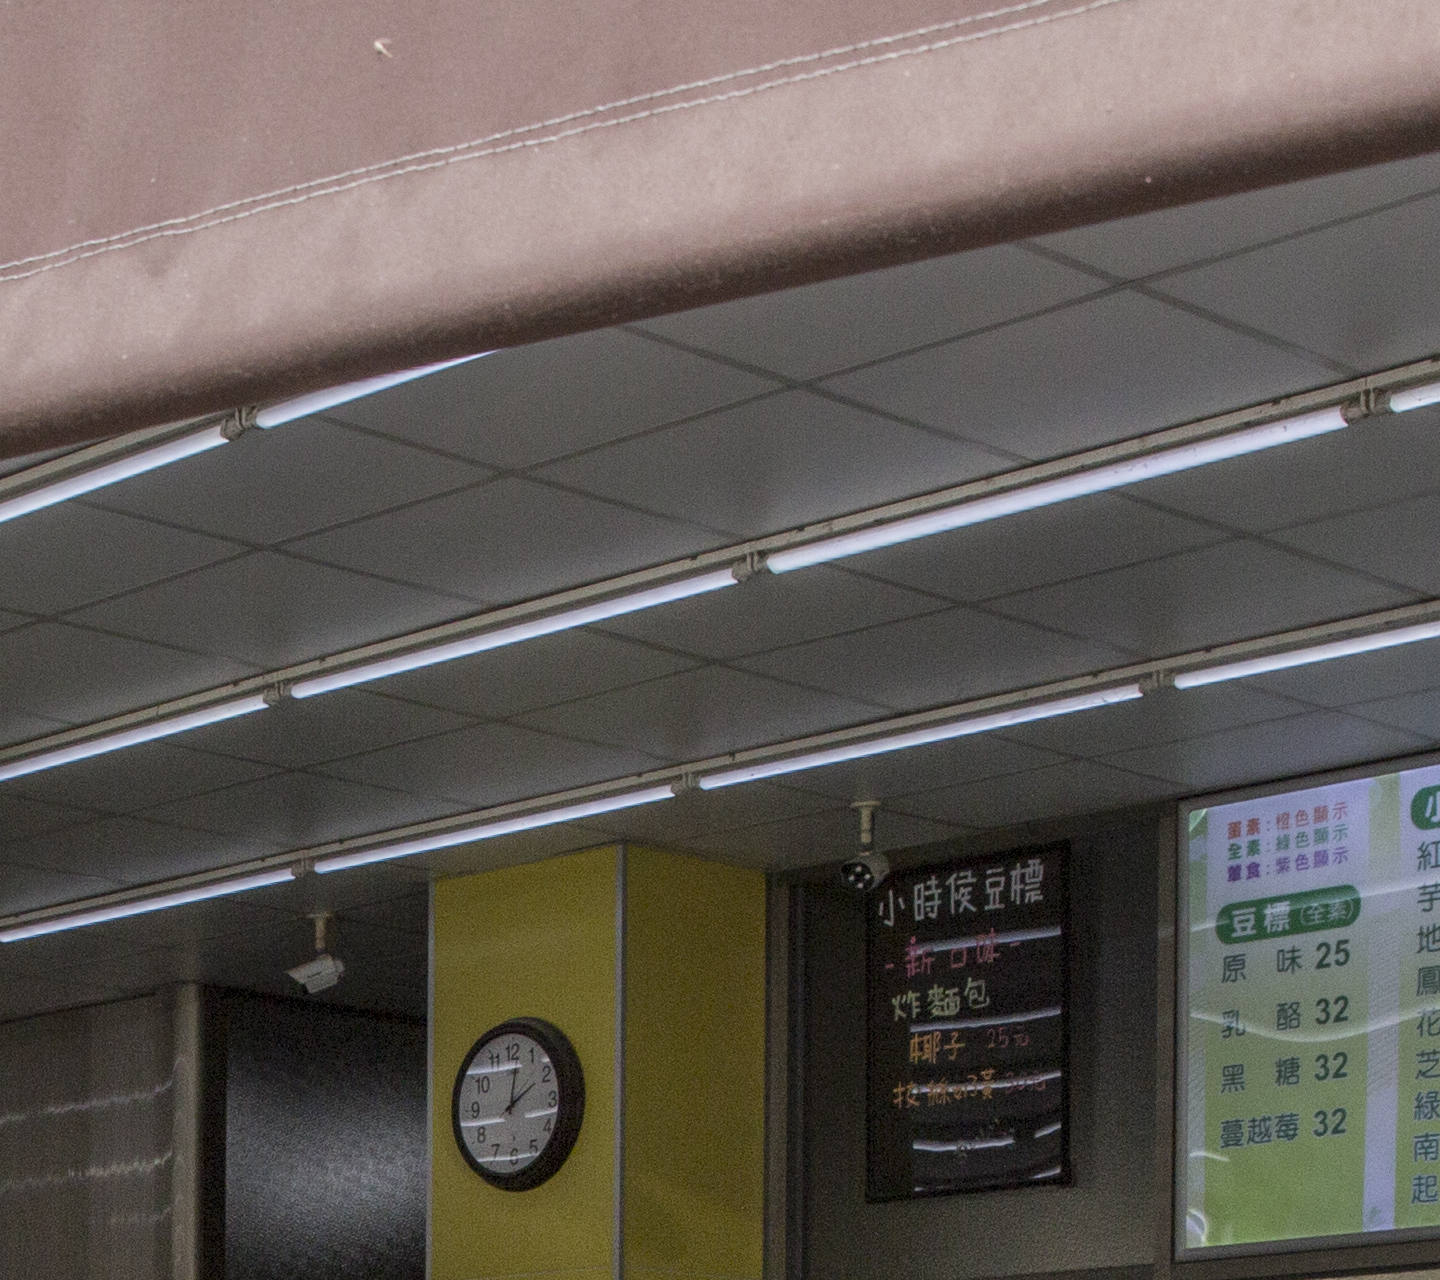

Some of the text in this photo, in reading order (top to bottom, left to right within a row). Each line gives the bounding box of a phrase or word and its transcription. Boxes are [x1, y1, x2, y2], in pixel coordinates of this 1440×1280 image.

[1221, 941, 1351, 983] 原味 25
[892, 977, 989, 1021] 炸麵包
[1221, 996, 1350, 1039] 乳酪 32
[507, 1043, 519, 1060] 12
[909, 1032, 966, 1064] 椰子
[542, 1066, 551, 1082] 2
[1221, 1052, 1348, 1093] 黑糖 32
[476, 1078, 490, 1093] 10
[471, 1102, 480, 1118] 9
[549, 1091, 557, 1108] 3
[477, 1127, 486, 1143] 8
[1220, 1108, 1347, 1148] 蔓越莓 32
